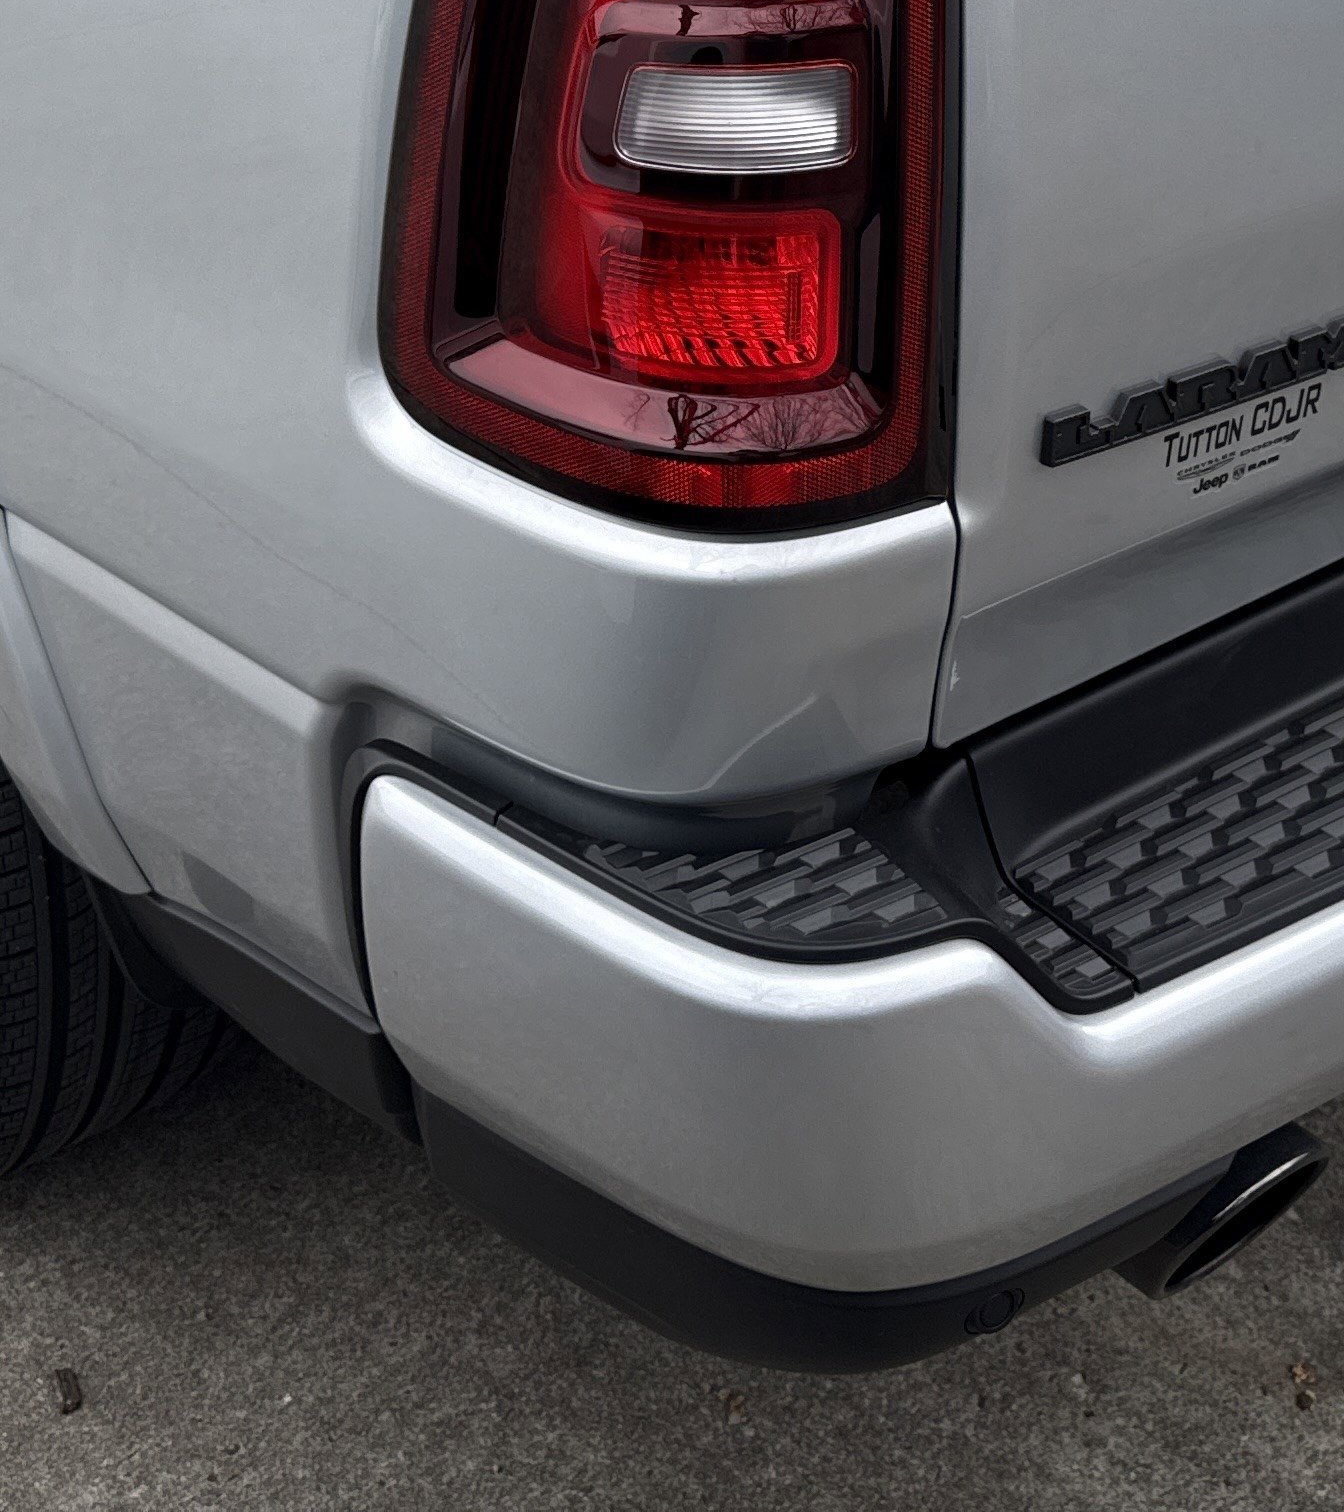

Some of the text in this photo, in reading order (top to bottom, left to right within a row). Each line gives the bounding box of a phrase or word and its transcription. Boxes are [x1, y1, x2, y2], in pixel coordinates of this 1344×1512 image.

[1163, 382, 1323, 468] TUTTON CDJR
[1192, 472, 1229, 495] Jeep
